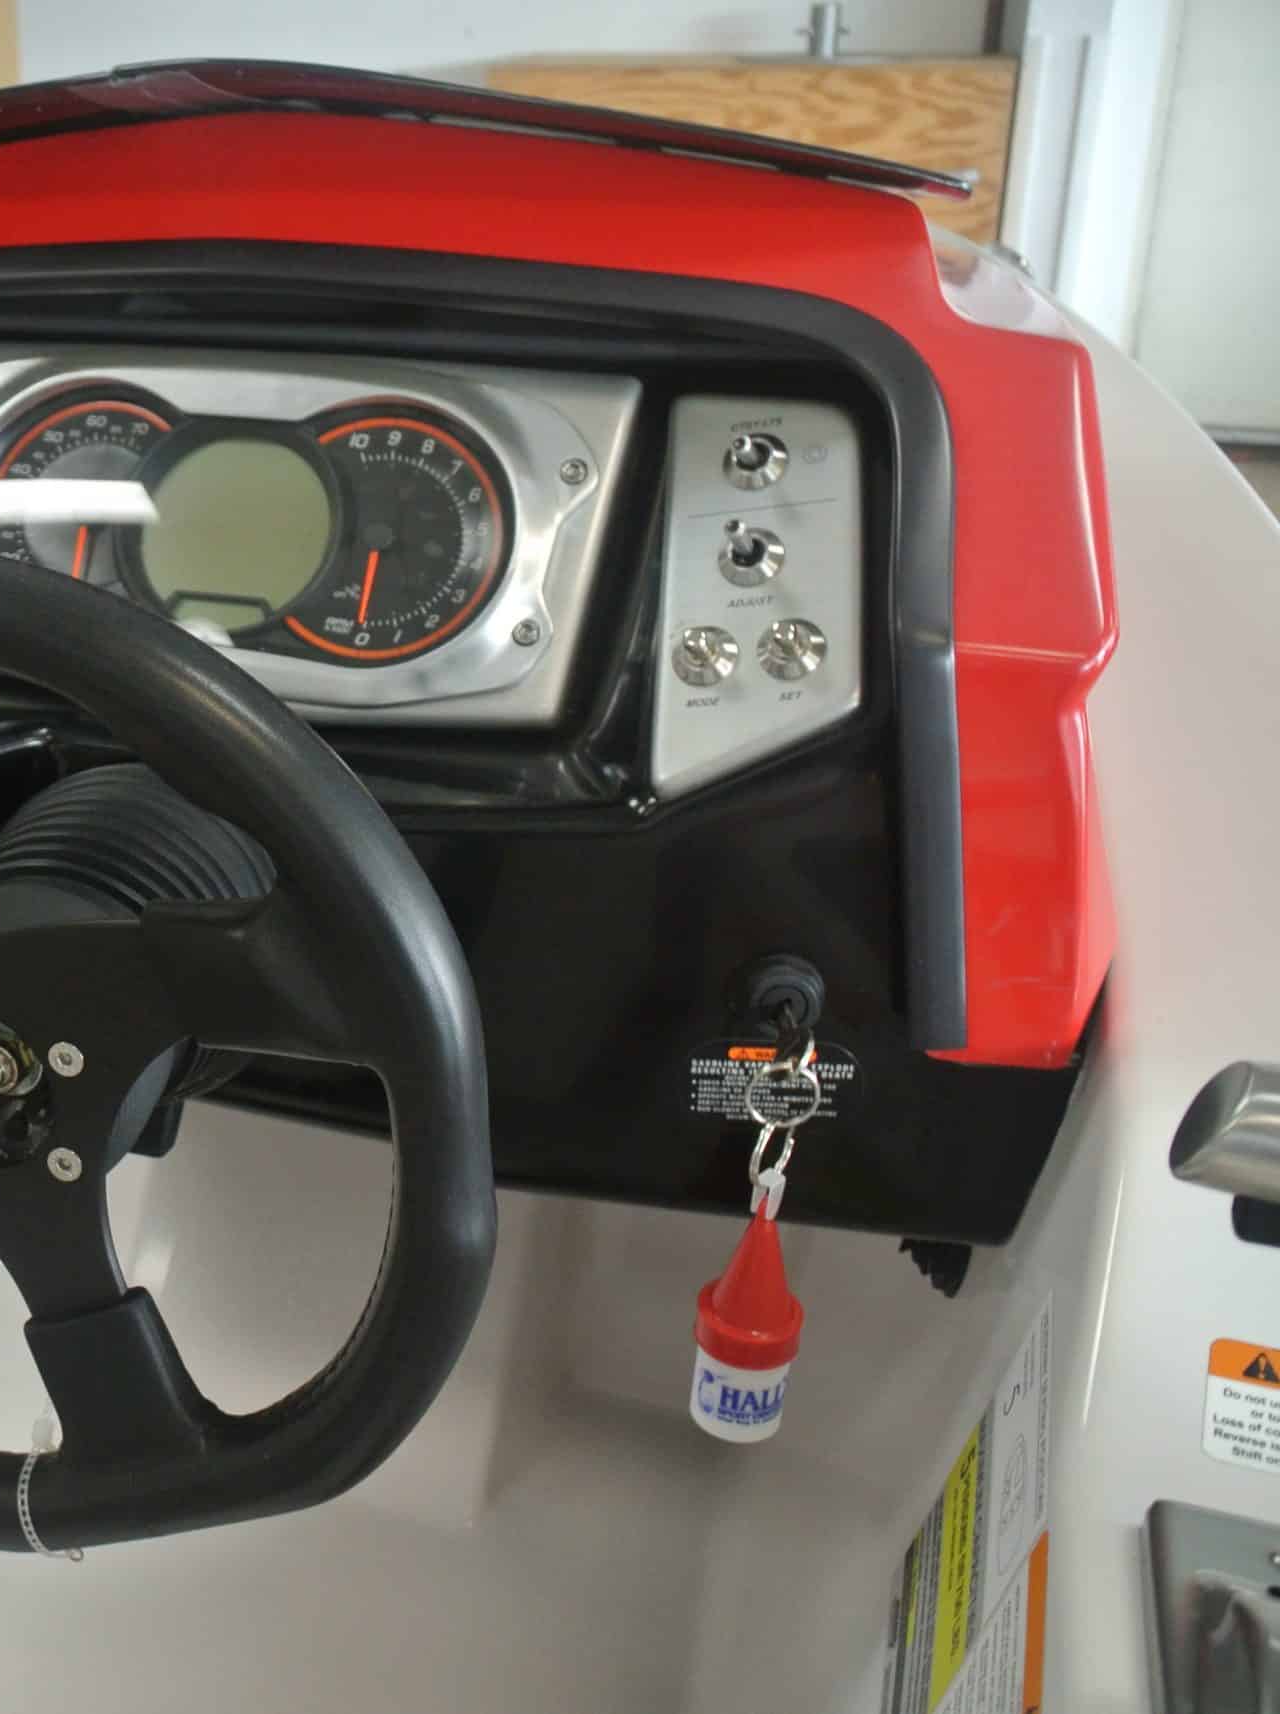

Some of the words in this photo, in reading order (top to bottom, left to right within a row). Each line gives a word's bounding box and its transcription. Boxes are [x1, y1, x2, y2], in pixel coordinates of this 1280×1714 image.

[348, 432, 370, 448] 10
[387, 430, 402, 446] 9
[422, 438, 436, 454] 8
[451, 459, 464, 476] 7
[469, 487, 482, 502] 6
[477, 521, 489, 537] 5
[451, 588, 466, 604] 3
[424, 614, 440, 629] 2
[354, 632, 370, 646] 0
[393, 629, 403, 643] 1
[686, 696, 720, 707] MODE
[779, 691, 802, 702] SET
[1223, 1387, 1241, 1400] Do
[1245, 1394, 1266, 1406] not
[1251, 1409, 1264, 1419] or
[1213, 1412, 1244, 1429] Loss
[1248, 1423, 1262, 1433] of
[1214, 1427, 1266, 1449] Reverse
[1232, 1445, 1262, 1463] Shift
